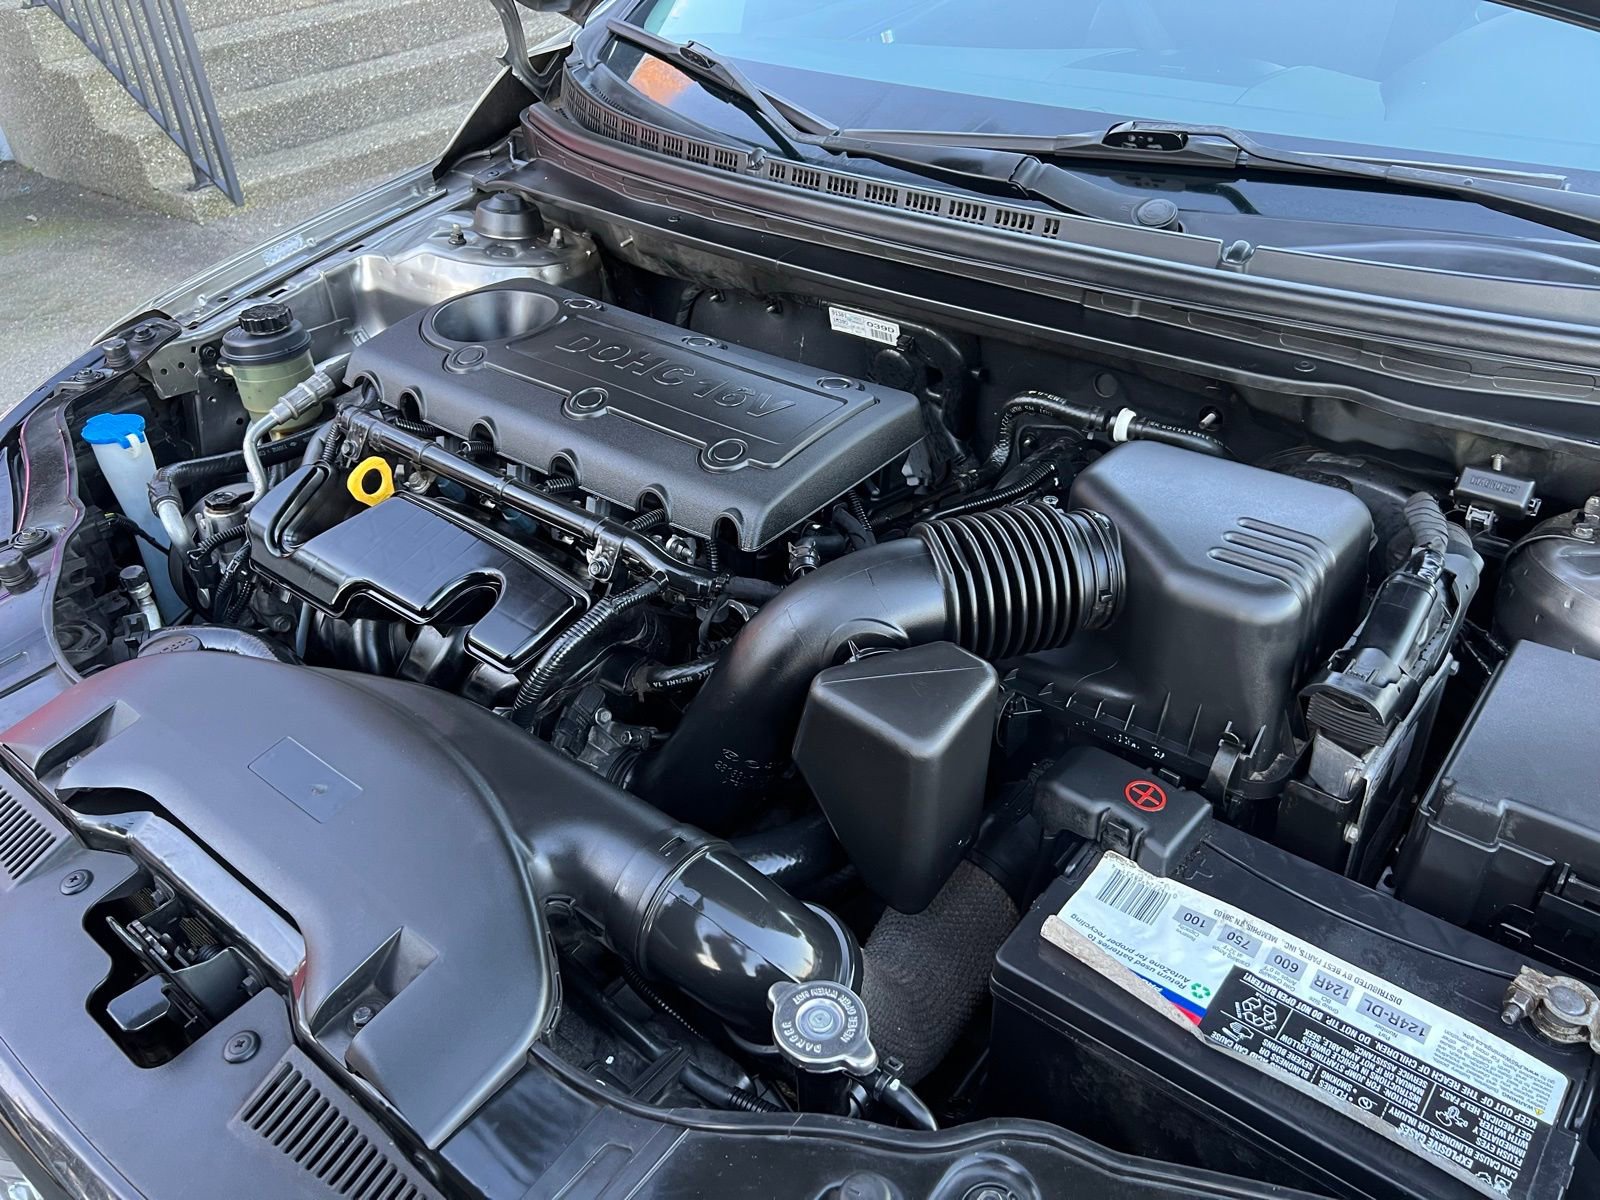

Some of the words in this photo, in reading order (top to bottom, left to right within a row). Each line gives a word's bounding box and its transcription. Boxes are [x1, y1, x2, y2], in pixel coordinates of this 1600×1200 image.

[554, 334, 696, 386] DOHC
[693, 379, 796, 417] 16V
[1069, 912, 1107, 938] recycling
[1182, 910, 1207, 929] 100
[1086, 932, 1096, 942] to
[1107, 933, 1135, 953] proper
[1225, 930, 1252, 950] 750
[1096, 938, 1133, 962] batteries
[1135, 949, 1148, 961] for
[1296, 946, 1322, 964] PARTS,
[1133, 957, 1155, 973] used
[1149, 957, 1190, 984] AutoZone
[1272, 953, 1300, 974] 600
[1322, 960, 1342, 974] BEST
[1155, 969, 1186, 990] Return
[1242, 971, 1278, 995] BATTERY!
[1341, 969, 1353, 980] BY
[1312, 973, 1351, 1000] 124R
[1353, 975, 1402, 1005] DISTRIBUTED
[1275, 989, 1297, 1006] OPEN
[1295, 1000, 1312, 1014] NOT
[1310, 1008, 1323, 1020] DO
[1324, 1015, 1339, 1028] TIP.
[1360, 997, 1427, 1039] 124R-DL
[781, 1020, 821, 1052] DANGER
[840, 1016, 857, 1042] NEVER
[1210, 1030, 1234, 1047] CAUSE
[1302, 1027, 1321, 1042] SEEK
[1337, 1022, 1358, 1037] NOT
[1356, 1032, 1371, 1044] DO
[1373, 1022, 1398, 1038] Number
[1233, 1042, 1249, 1054] CAN
[1257, 1046, 1270, 1058] OR
[1261, 1038, 1287, 1056] BURNS
[1279, 1033, 1309, 1053] FOLLOW
[1300, 1035, 1331, 1056] OWNERS
[1320, 1036, 1360, 1062] AVAILABLE,
[1285, 1050, 1314, 1070] SEVERE
[1307, 1047, 1345, 1072] STARTING,
[1330, 1051, 1360, 1071] VEHICLE
[1351, 1043, 1397, 1072] ASSISTANCE.
[1372, 1039, 1418, 1068] CHILDREN.
[1269, 1052, 1310, 1078] BLINDNESS
[1359, 1057, 1376, 1070] NOT
[1359, 1066, 1369, 1076] IN
[1373, 1064, 1383, 1074] IF
[1417, 1062, 1431, 1075] OF
[1319, 1069, 1353, 1091] SMOKING
[1343, 1067, 1365, 1083] JUMP
[1381, 1068, 1394, 1080] OR
[1396, 1067, 1429, 1088] SERVICE
[1430, 1069, 1461, 1090] REACH
[1317, 1078, 1349, 1099] FLAMES
[1364, 1078, 1381, 1091] FOR
[1368, 1070, 1422, 1104] INSTRUCTIONS
[1392, 1074, 1425, 1096] MANUAL
[1460, 1084, 1480, 1100] THE
[1381, 1087, 1419, 1111] CAUTION:
[1436, 1087, 1460, 1104] FAST.
[1479, 1094, 1494, 1107] OF
[1387, 1105, 1418, 1126] INJURY
[1459, 1099, 1481, 1115] HELP
[1493, 1101, 1514, 1117] OUT
[1416, 1120, 1430, 1133] OR
[1475, 1116, 1508, 1138] WATER.
[1480, 1109, 1516, 1133] MEDICAL
[1513, 1111, 1537, 1129] KEEP
[1395, 1121, 1427, 1144] GASES
[1428, 1126, 1474, 1156] BLINDNESS
[1471, 1124, 1526, 1158] IMMEDIATELY
[1506, 1132, 1529, 1149] WITH
[1514, 1127, 1532, 1141] GET
[1424, 1136, 1474, 1168] EXPLOSIVE
[1474, 1136, 1496, 1152] EYES
[1472, 1150, 1501, 1170] CAUSE
[1495, 1147, 1523, 1166] FLUSH
[1499, 1164, 1518, 1179] CAN
